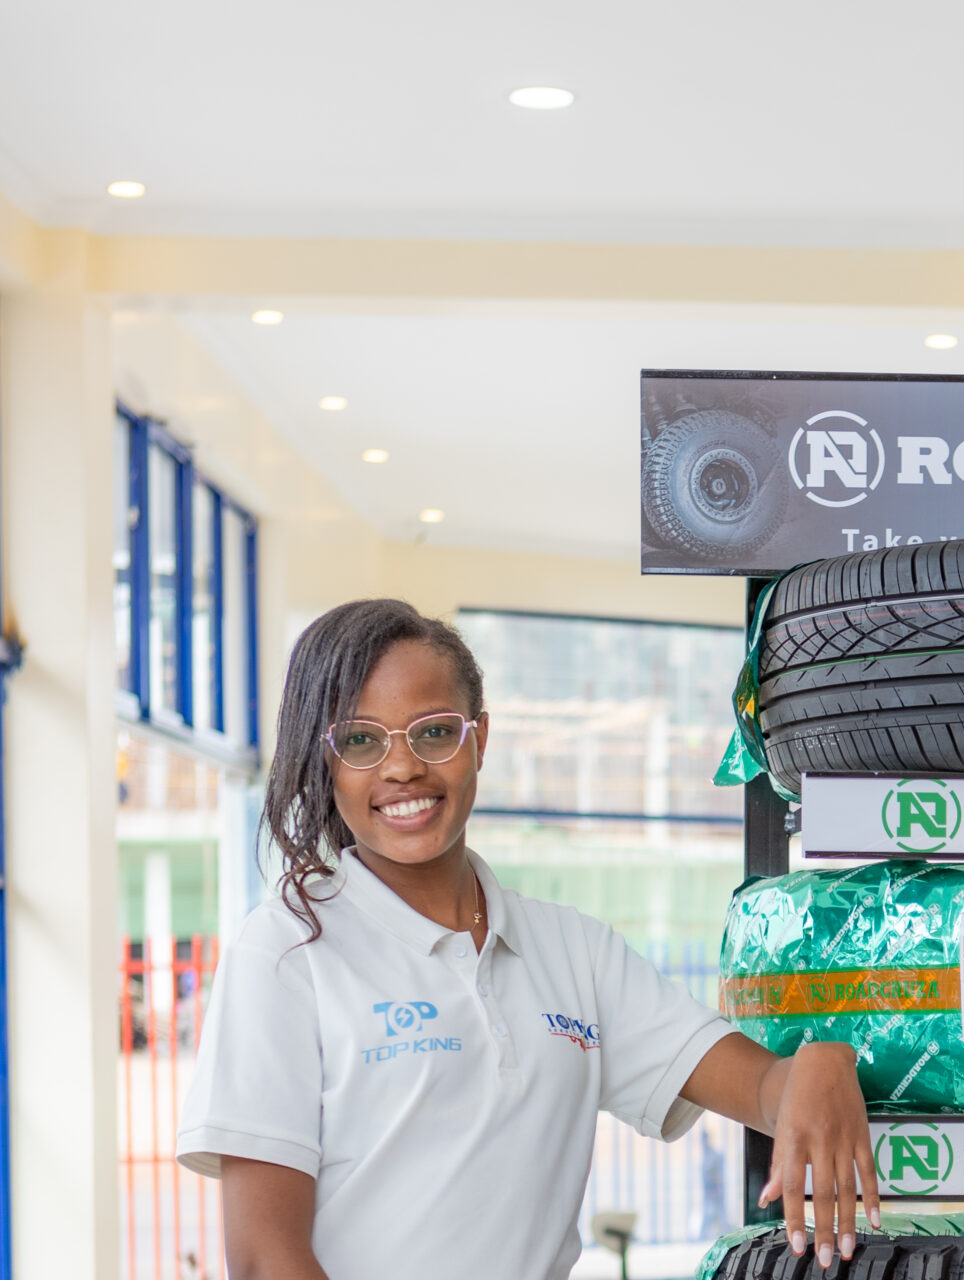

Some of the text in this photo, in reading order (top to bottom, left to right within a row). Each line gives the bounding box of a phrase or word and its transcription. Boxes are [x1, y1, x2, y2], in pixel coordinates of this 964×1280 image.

[841, 528, 923, 552] Take
[834, 980, 941, 1002] ROADCRUZA
[361, 1037, 462, 1064] TOP KING
[889, 1053, 931, 1102] ROADCRUZA
